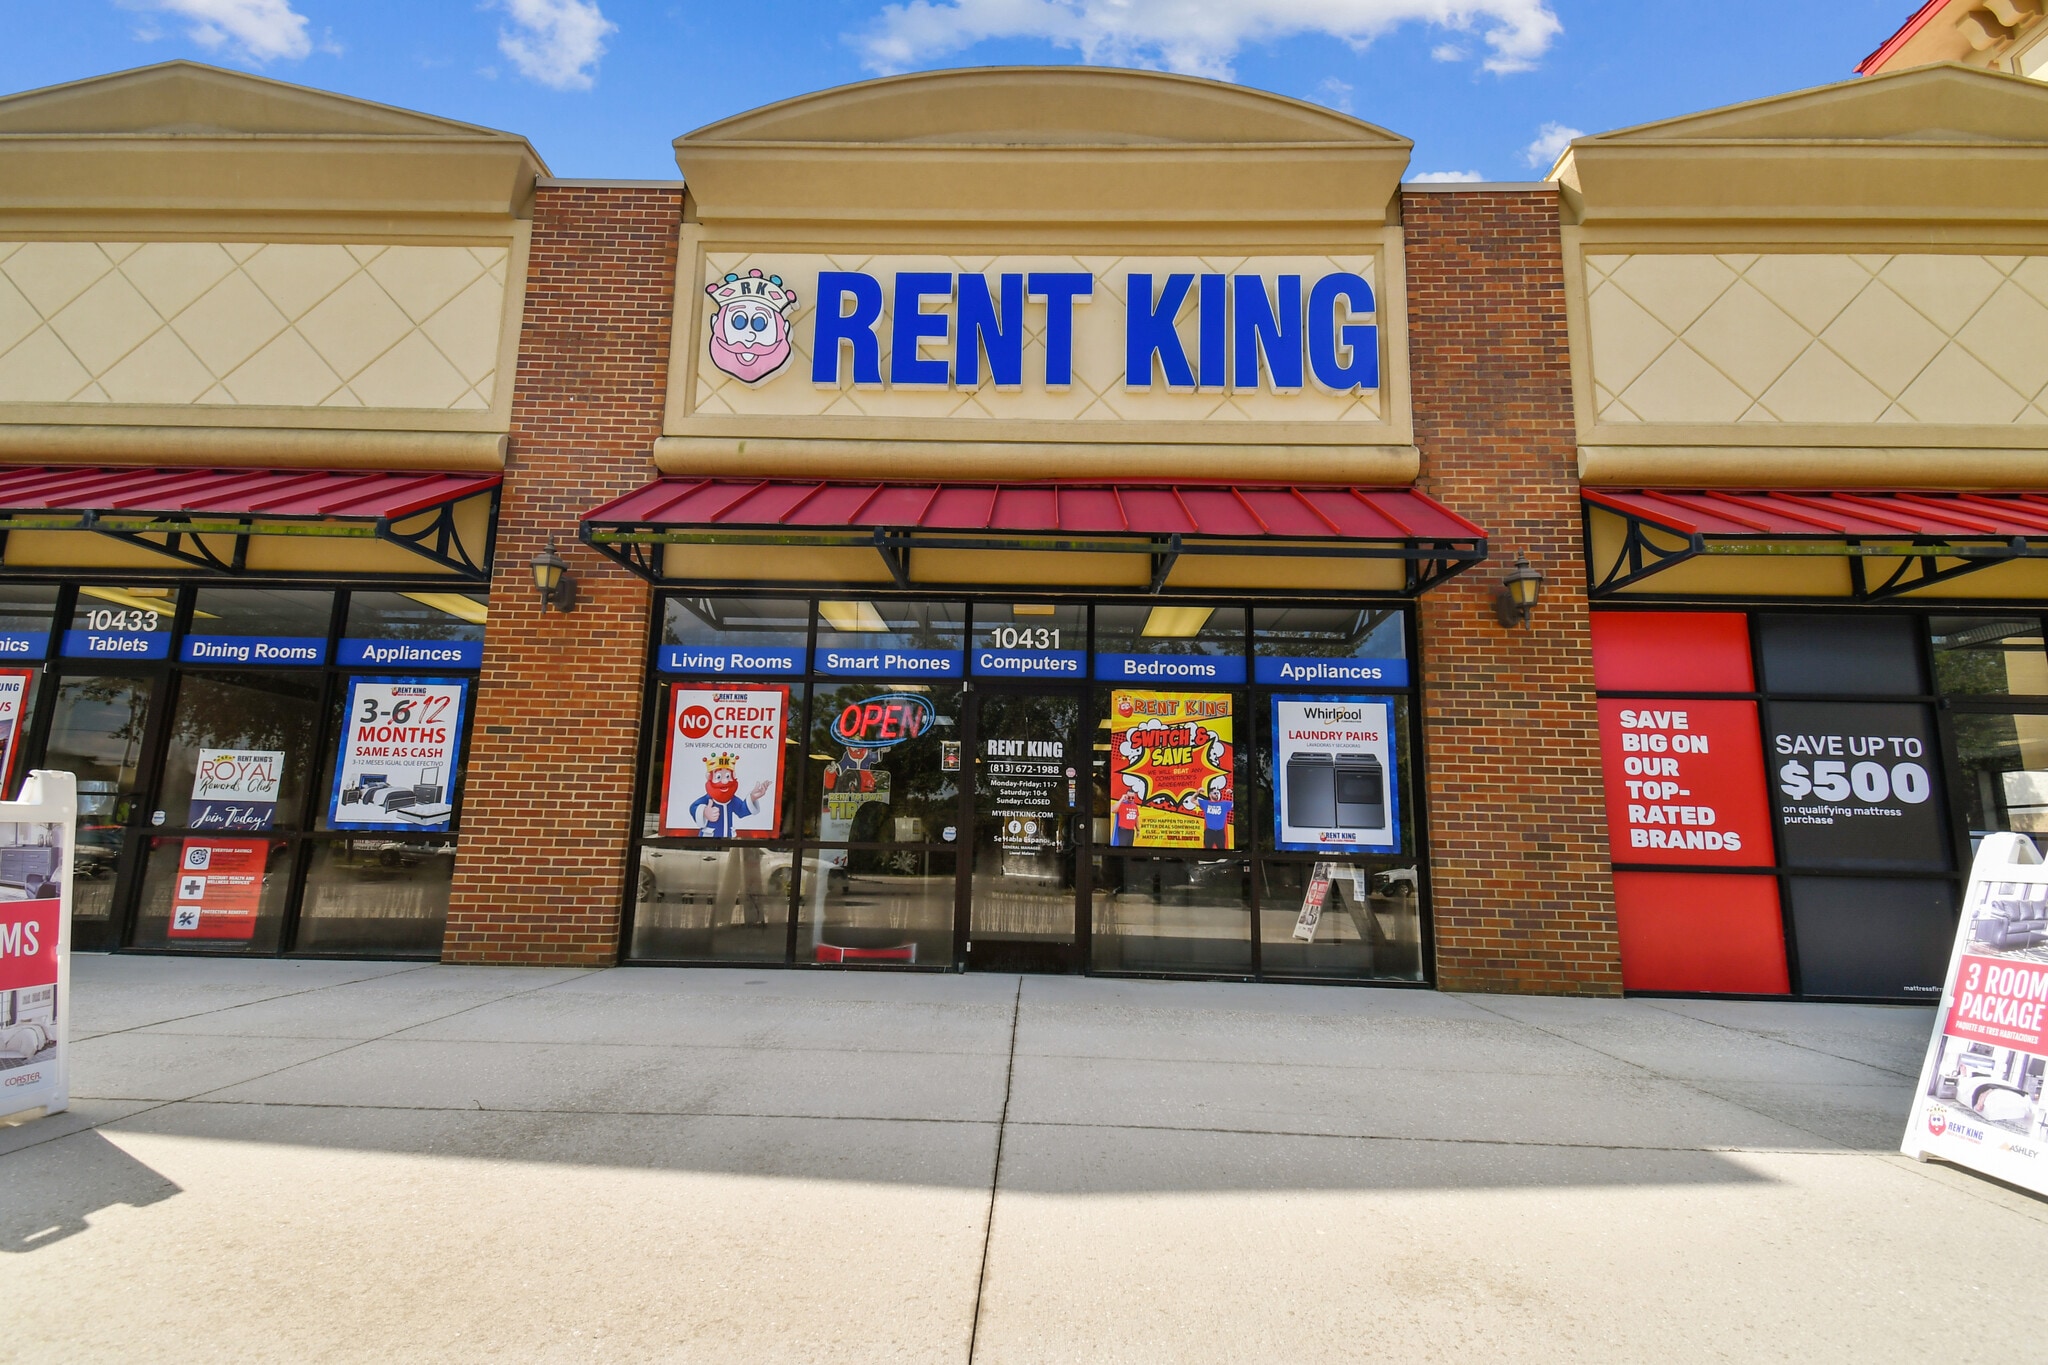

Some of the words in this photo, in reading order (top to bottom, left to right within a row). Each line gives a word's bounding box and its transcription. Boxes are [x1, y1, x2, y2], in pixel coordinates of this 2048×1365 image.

[810, 270, 1094, 390] RENT
[1123, 270, 1379, 394] KING
[86, 610, 158, 632] 10433
[87, 636, 149, 652] Tablets
[991, 627, 1061, 649] 10431
[192, 641, 249, 661] Dining
[254, 643, 317, 659] Rooms
[362, 644, 462, 664] Appliances
[671, 653, 725, 671] Living
[730, 654, 792, 669] Rooms
[826, 654, 879, 669] Smart
[884, 655, 950, 670] Phones
[980, 654, 1077, 674] Computers
[1124, 660, 1216, 676] Bedrooms
[1280, 663, 1382, 682] Appliances
[418, 696, 451, 724] 12
[683, 714, 710, 729] NO
[714, 707, 776, 721] CREDIT
[1133, 699, 1180, 716] RENT
[1185, 700, 1228, 717] KING
[1304, 707, 1362, 723] Whirlpool
[838, 704, 923, 739] OPEN
[1619, 710, 1689, 730] SAVE
[357, 726, 446, 743] MONTHS
[712, 724, 774, 739] CHECK
[1131, 728, 1191, 749] SWITCH
[1194, 726, 1210, 747] &
[1289, 730, 1343, 741] LAUNDRY
[1346, 731, 1379, 741] PAIRS
[356, 746, 390, 757] SAME
[392, 747, 408, 757] AS
[410, 748, 443, 758] CASH
[987, 739, 1024, 756] RENT
[1027, 741, 1063, 758] KING
[1622, 733, 1668, 753] BIG
[1671, 735, 1709, 754] ON
[1775, 735, 1844, 756] SAVE
[1848, 736, 1885, 756] UP
[1888, 737, 1923, 758] TO
[1151, 747, 1193, 767] SAVE
[1624, 757, 1680, 777] OUR
[200, 761, 277, 782] ROYAL
[990, 764, 1014, 773] (813)
[1015, 765, 1060, 774] 672-1988
[1155, 774, 1198, 782] COMPETITOR'S
[200, 776, 241, 796] Rewards
[247, 779, 273, 793] Club
[990, 780, 1042, 788] Monday-Friday:
[1625, 781, 1690, 800] TOP-
[1779, 759, 1931, 804] $500
[829, 793, 849, 801] RENT
[862, 793, 883, 801] OWN
[996, 797, 1024, 805] Sunday:
[999, 789, 1032, 797] Saturday:
[190, 805, 224, 829] Join
[225, 806, 273, 831] Today!
[991, 810, 1054, 818] MYRENTKING.COM
[1628, 805, 1716, 826] RATED
[1782, 806, 1797, 815] on
[1798, 804, 1852, 818] qualifying
[1854, 807, 1902, 816] mattress
[1783, 814, 1834, 826] purchase
[1003, 835, 1023, 843] Habla
[1631, 829, 1742, 851] BRANDS
[0, 920, 40, 958] MS
[1965, 963, 1982, 991] 3
[1984, 965, 2048, 1002] ROOM
[1958, 991, 2046, 1031] PACKAGE
[1955, 1020, 1978, 1033] PAQUETE
[1977, 1024, 1987, 1034] DE
[1986, 1026, 1999, 1037] TRES
[1999, 1029, 2039, 1044] HABITACIONES
[4, 1071, 41, 1087] COASTER
[1948, 1121, 1966, 1135] RENT
[1965, 1125, 1984, 1141] KING
[2008, 1144, 2039, 1158] ASHLEY
